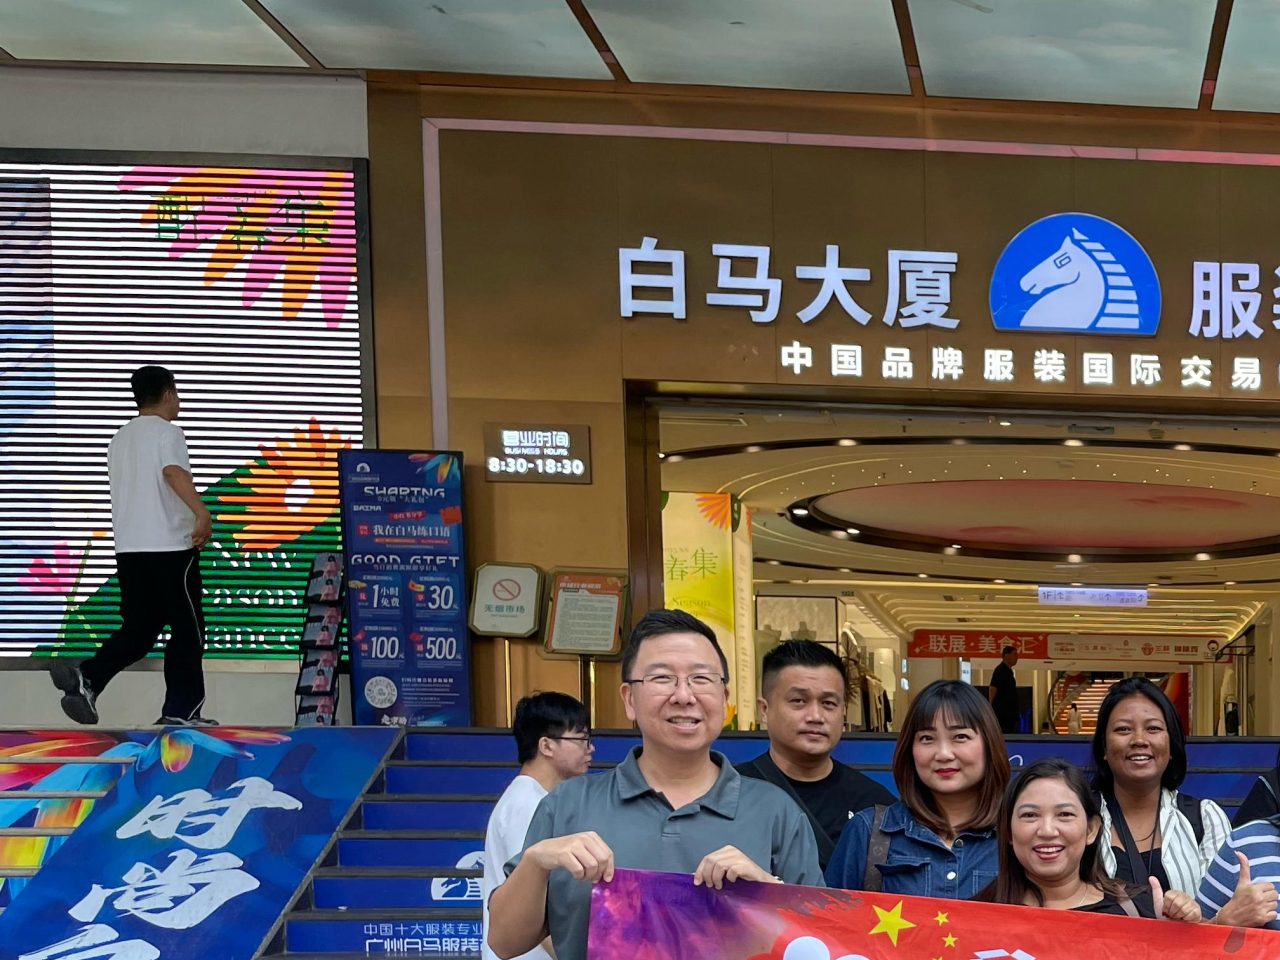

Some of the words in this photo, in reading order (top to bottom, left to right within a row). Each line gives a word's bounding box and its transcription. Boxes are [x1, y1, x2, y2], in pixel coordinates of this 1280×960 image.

[618, 237, 961, 330] 白马大厦
[502, 431, 569, 448] 营业时间
[488, 457, 584, 476] 8:30-18:30
[365, 938, 483, 952] 广州白马服装
